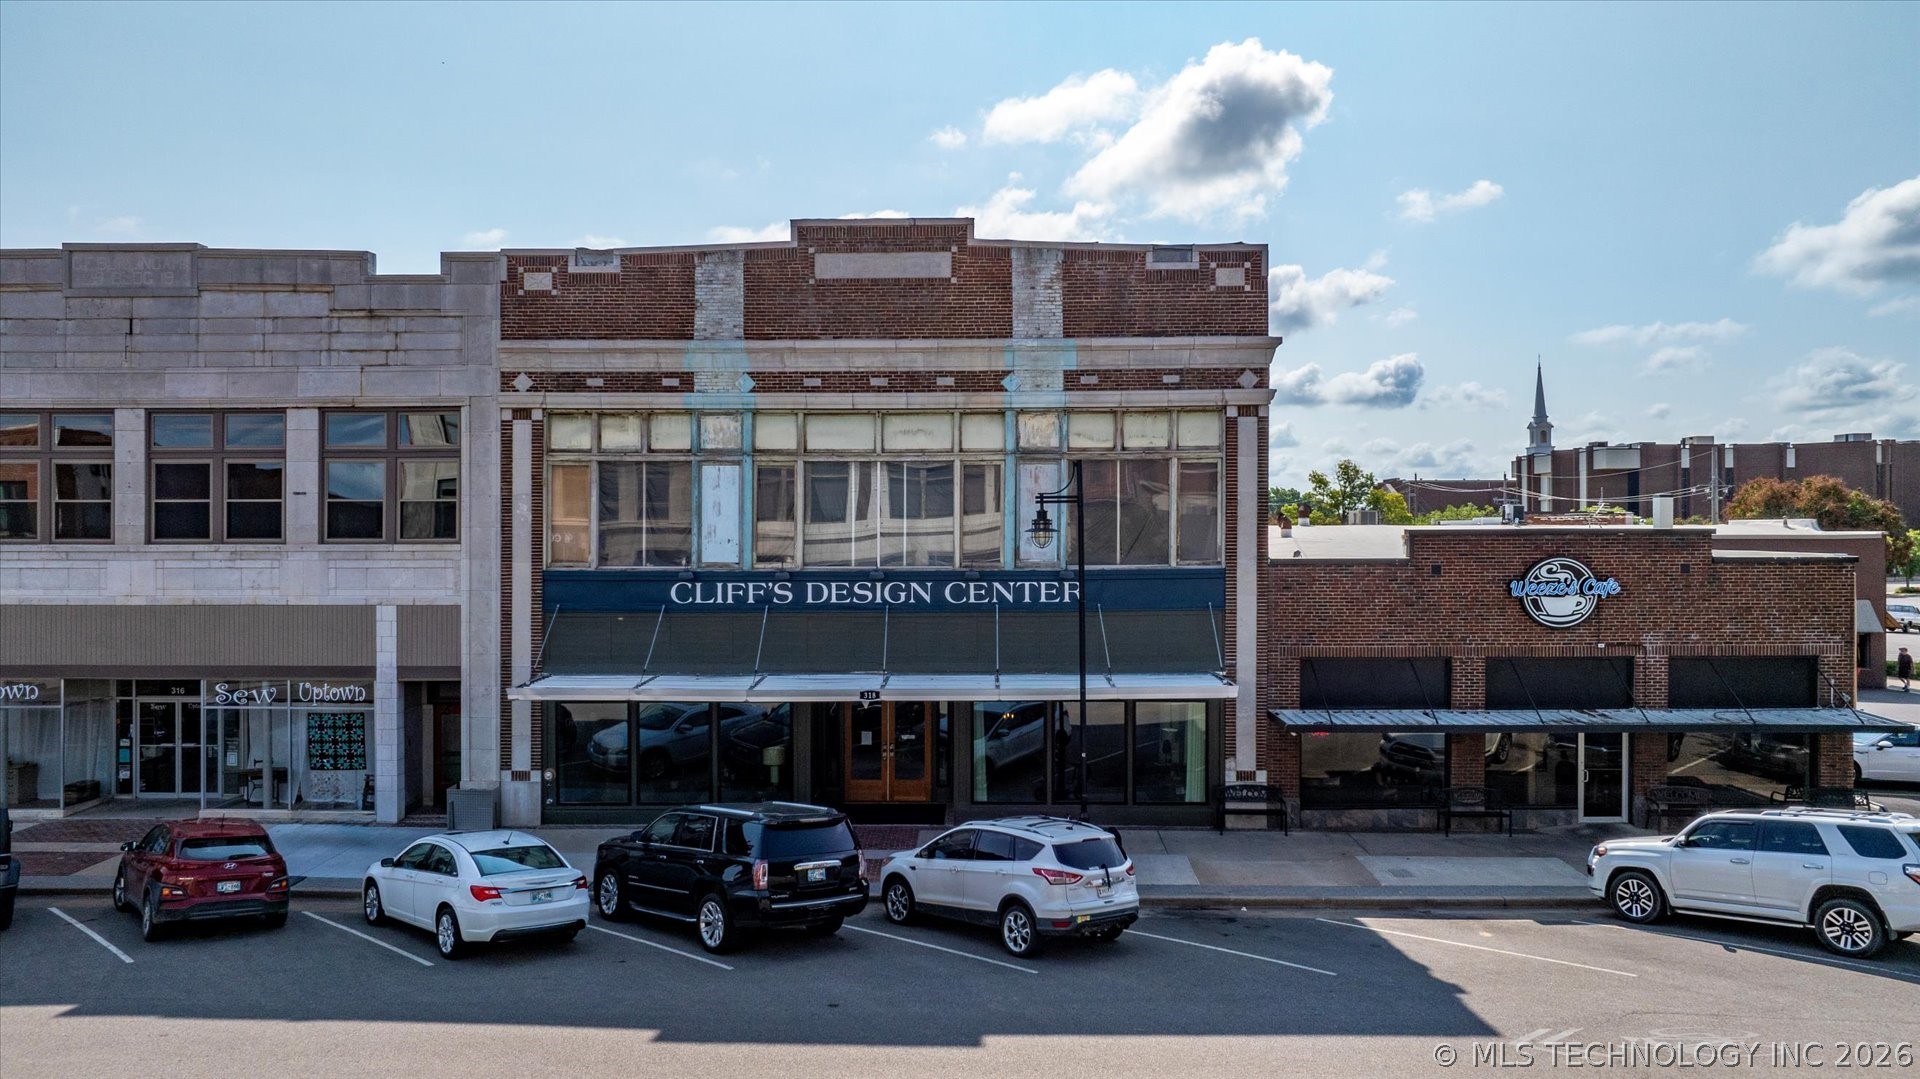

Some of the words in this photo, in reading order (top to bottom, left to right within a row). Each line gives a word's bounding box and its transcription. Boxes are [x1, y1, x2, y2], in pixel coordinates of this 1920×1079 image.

[670, 581, 794, 604] CLIFF'S
[805, 581, 933, 604] DESIGN
[944, 581, 1080, 604] CENTER
[1510, 579, 1578, 597] Weeze's
[1582, 577, 1621, 599] Cafe
[170, 687, 185, 695] 316
[215, 682, 277, 705] Sew
[298, 682, 366, 706] Uptown
